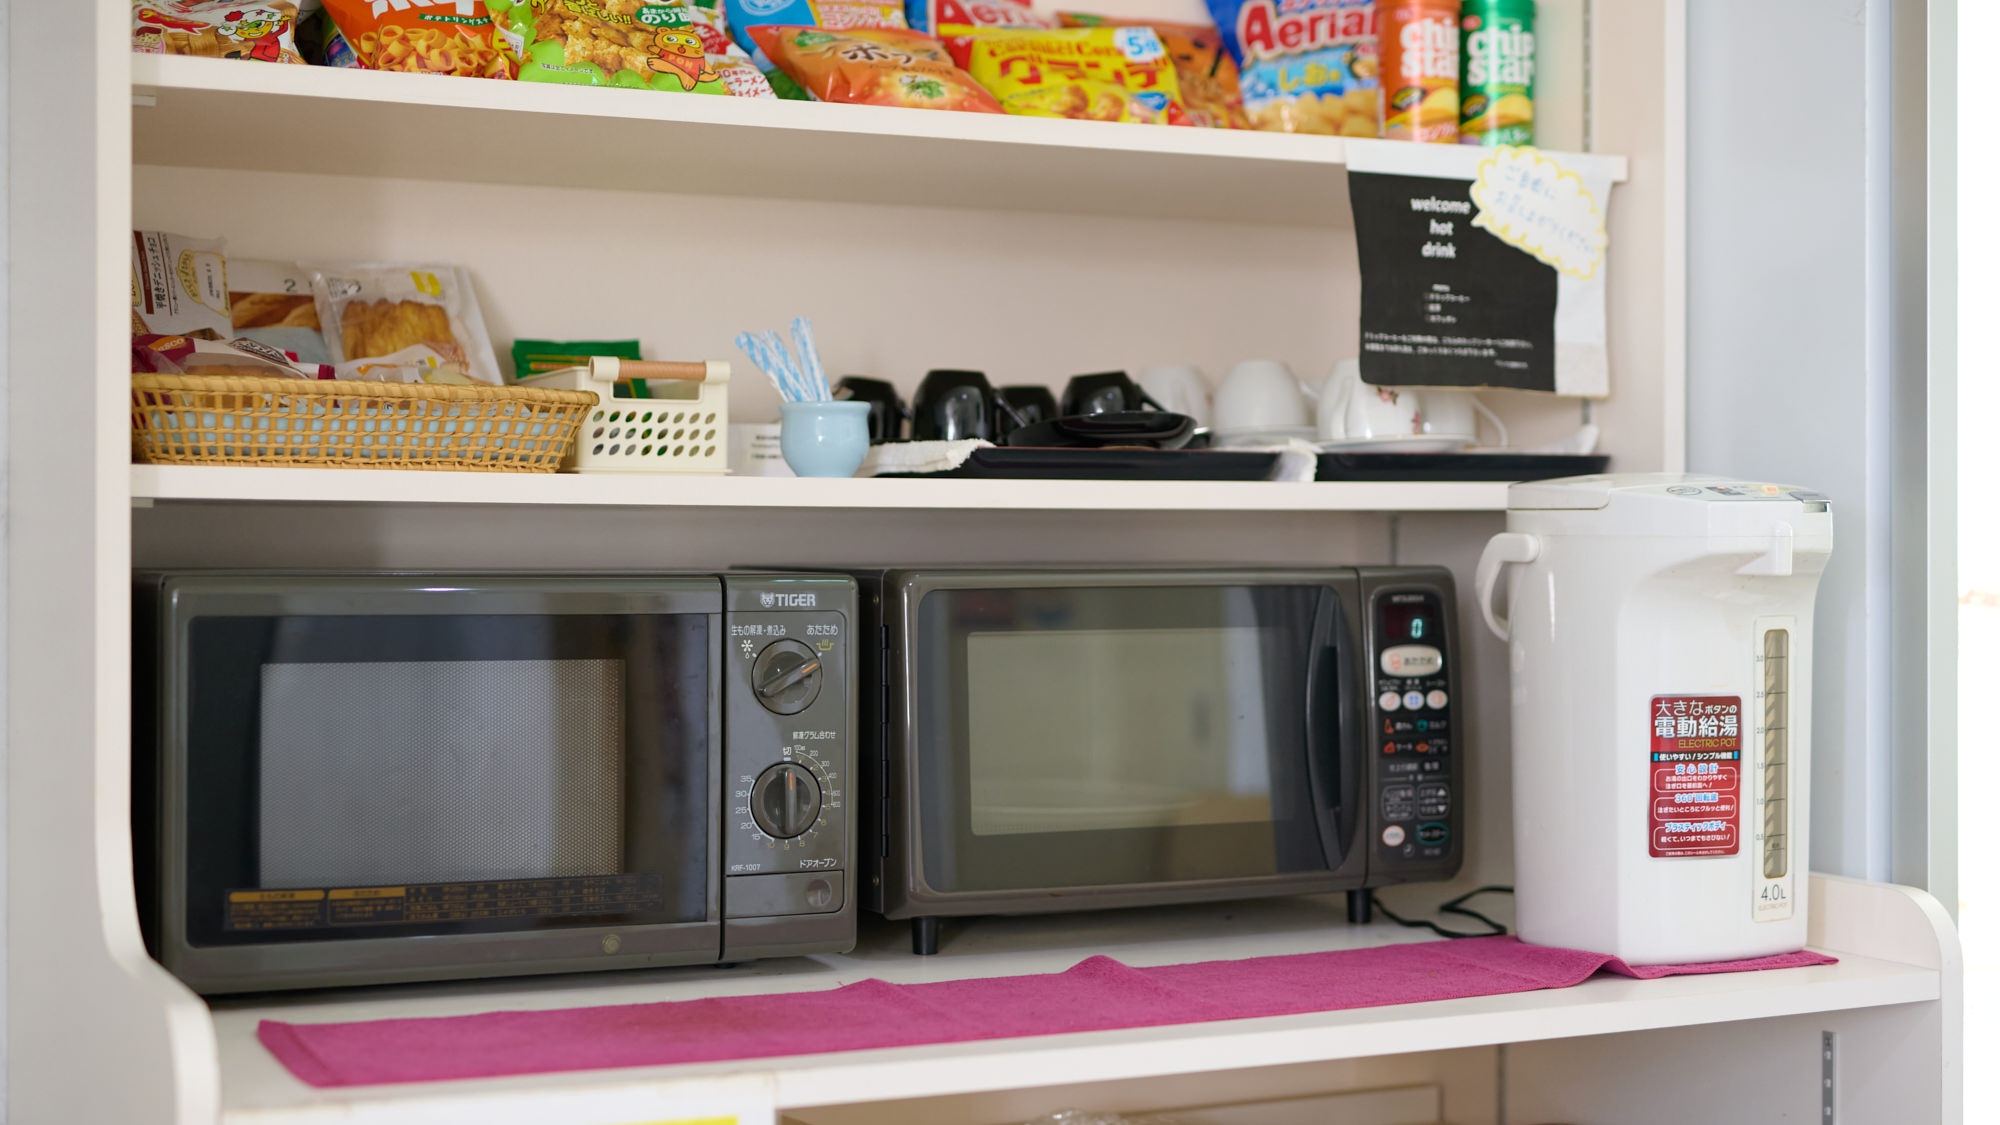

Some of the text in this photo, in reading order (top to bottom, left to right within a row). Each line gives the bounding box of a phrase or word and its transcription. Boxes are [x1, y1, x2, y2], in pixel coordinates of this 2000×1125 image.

[1399, 18, 1459, 51] chi
[1400, 50, 1459, 78] sta
[1410, 196, 1471, 214] welcome
[1429, 218, 1454, 236] hot
[1421, 241, 1456, 258] drink
[775, 593, 816, 607] TIGER
[806, 624, 839, 636] あたため
[1411, 618, 1423, 638] 0
[1655, 699, 1738, 717] 大きなボタンの
[1654, 715, 1739, 738] 電動給湯
[1678, 737, 1737, 749] ELECTRIC POT
[1675, 762, 1719, 775] 安心設計
[735, 806, 747, 814] 25
[1664, 820, 1727, 833] プラスティックボディ
[799, 858, 837, 869] ドアオープン
[1761, 884, 1787, 901] 4.0L
